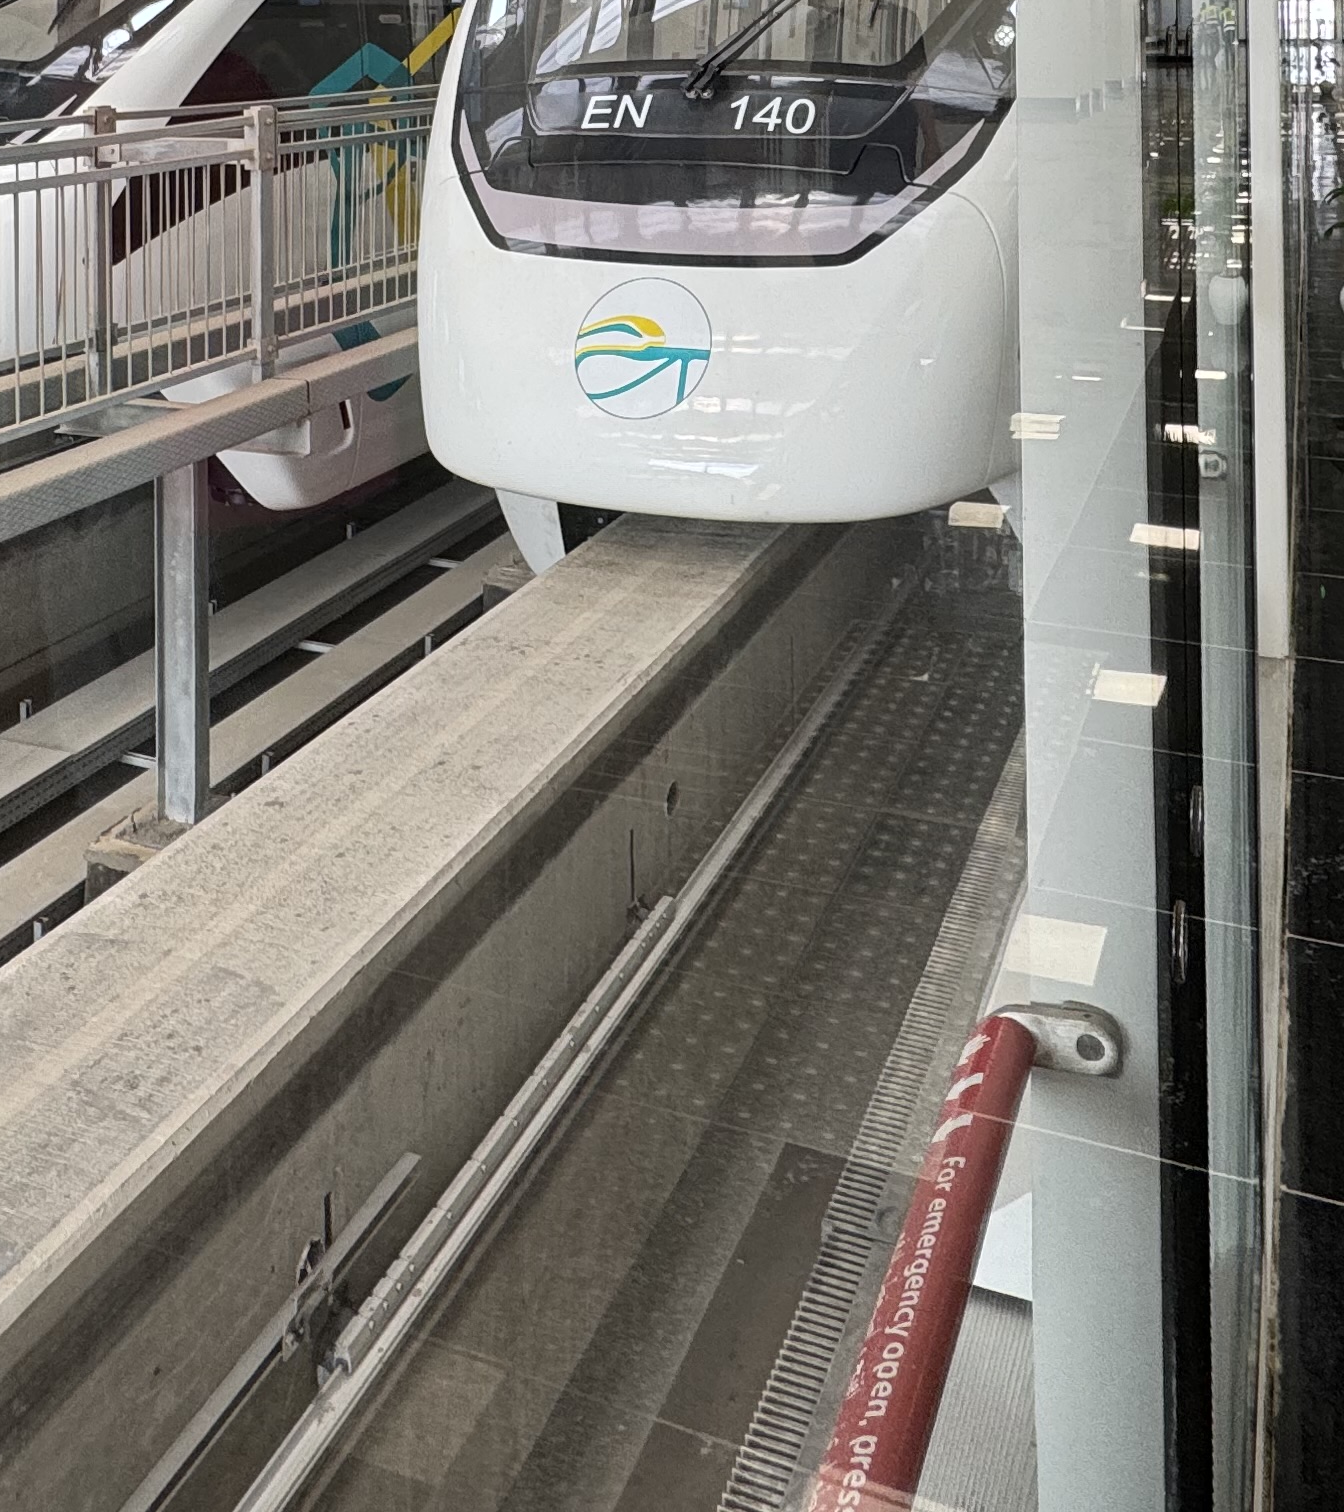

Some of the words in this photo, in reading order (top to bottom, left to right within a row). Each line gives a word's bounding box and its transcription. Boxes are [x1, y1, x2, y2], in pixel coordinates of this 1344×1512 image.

[580, 93, 654, 130] EN
[728, 94, 817, 135] 140
[934, 1156, 966, 1192] For
[884, 1197, 947, 1337] emergency
